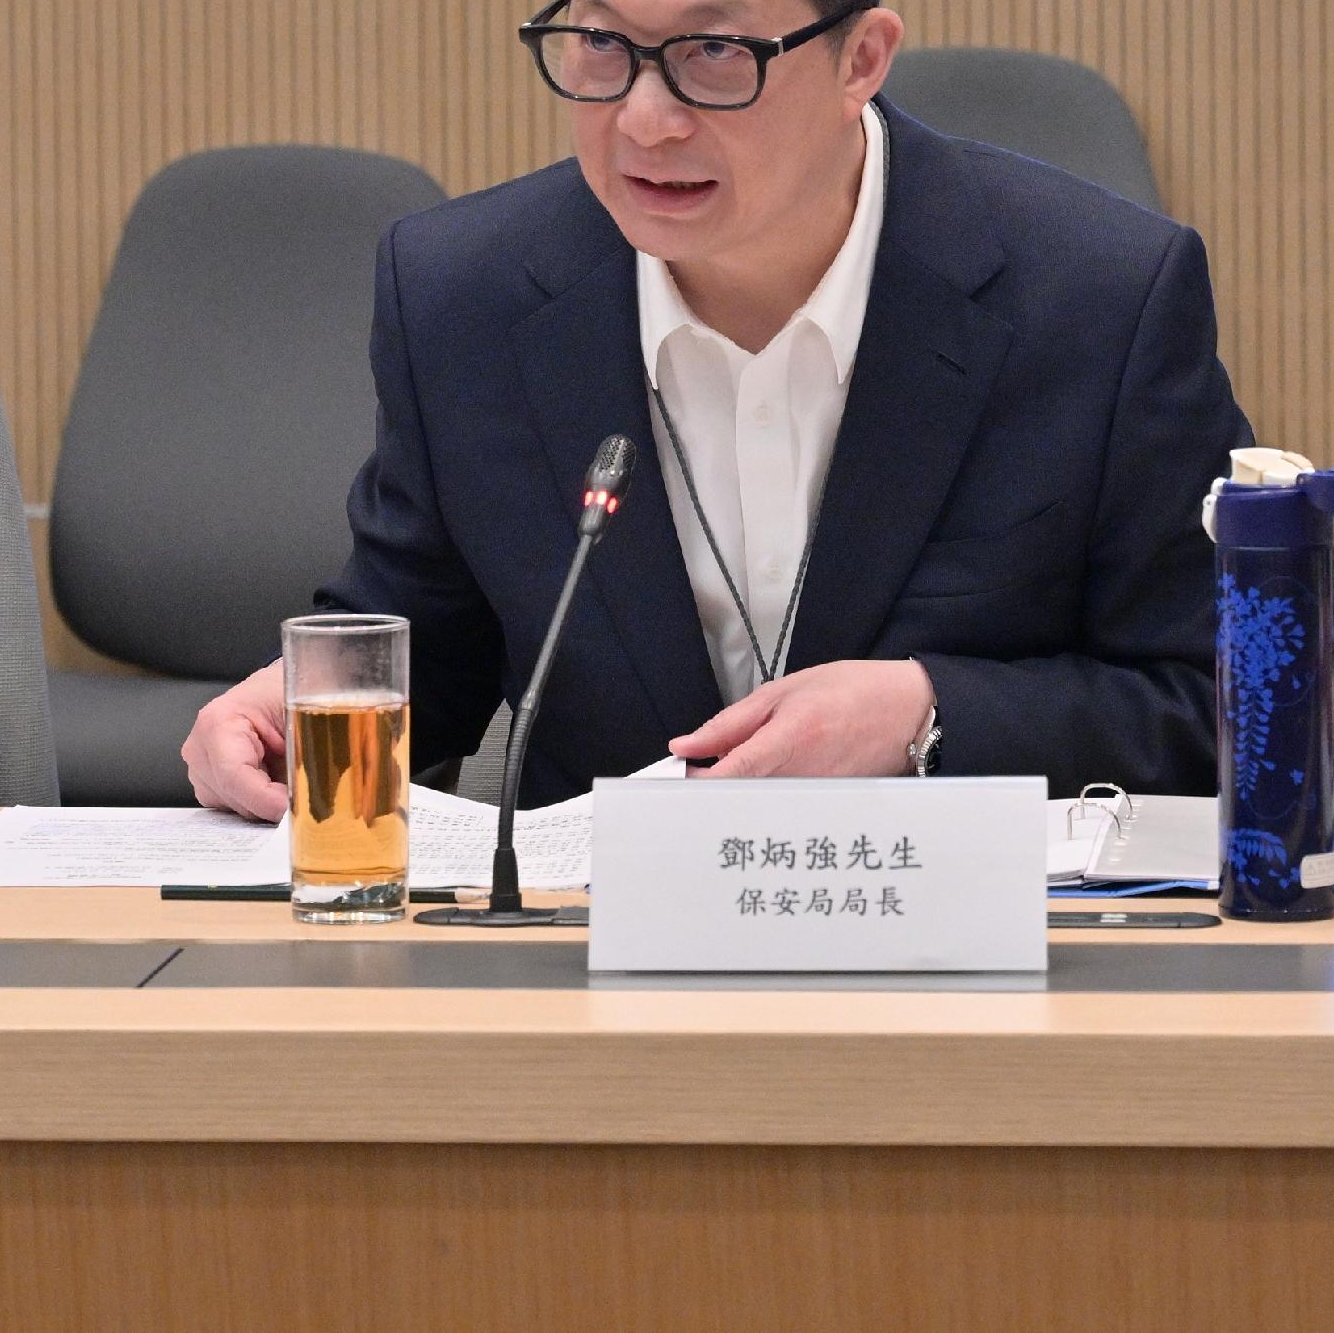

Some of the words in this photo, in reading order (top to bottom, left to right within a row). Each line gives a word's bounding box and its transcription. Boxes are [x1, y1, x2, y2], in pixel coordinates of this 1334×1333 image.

[718, 834, 924, 872] 鄧炳強先生
[735, 885, 906, 918] 保安局局長
